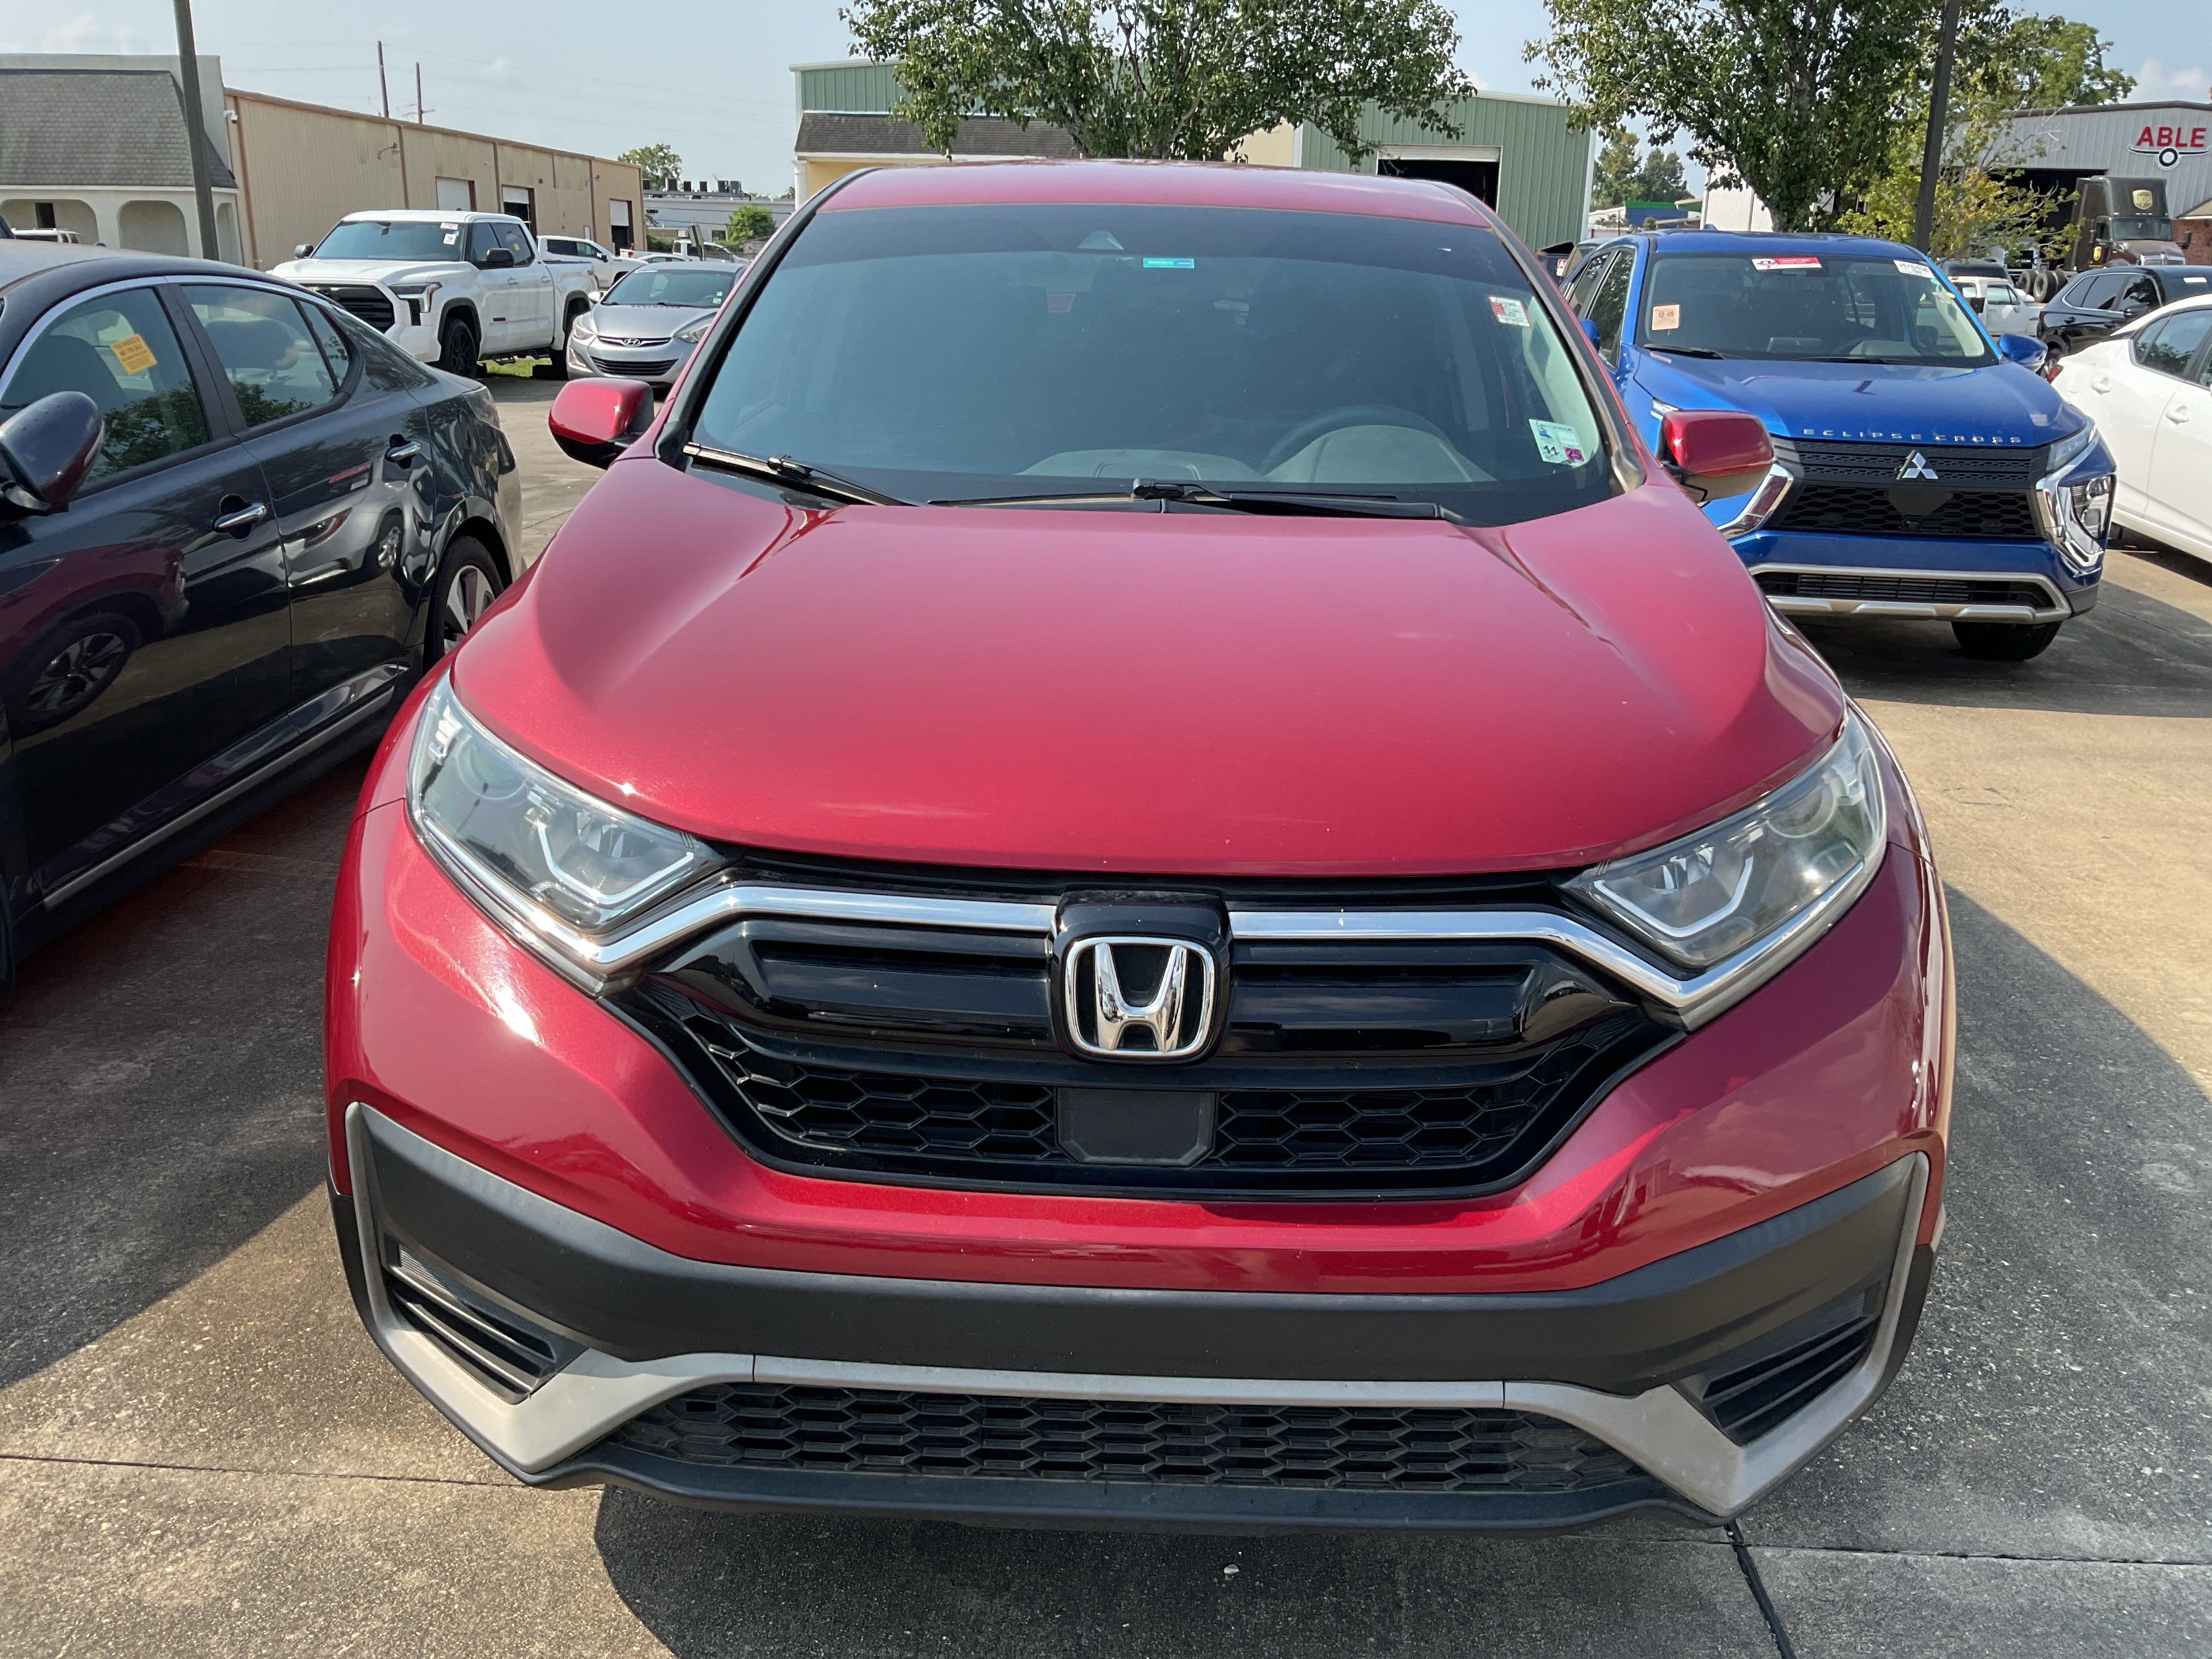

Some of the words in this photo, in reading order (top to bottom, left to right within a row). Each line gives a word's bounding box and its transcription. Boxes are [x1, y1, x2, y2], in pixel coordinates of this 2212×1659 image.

[2136, 126, 2207, 147] ABLE
[2136, 195, 2151, 206] ups
[1803, 428, 1922, 439] ECLIPSE
[1935, 435, 2021, 443] CROSS
[1566, 448, 1581, 459] 25
